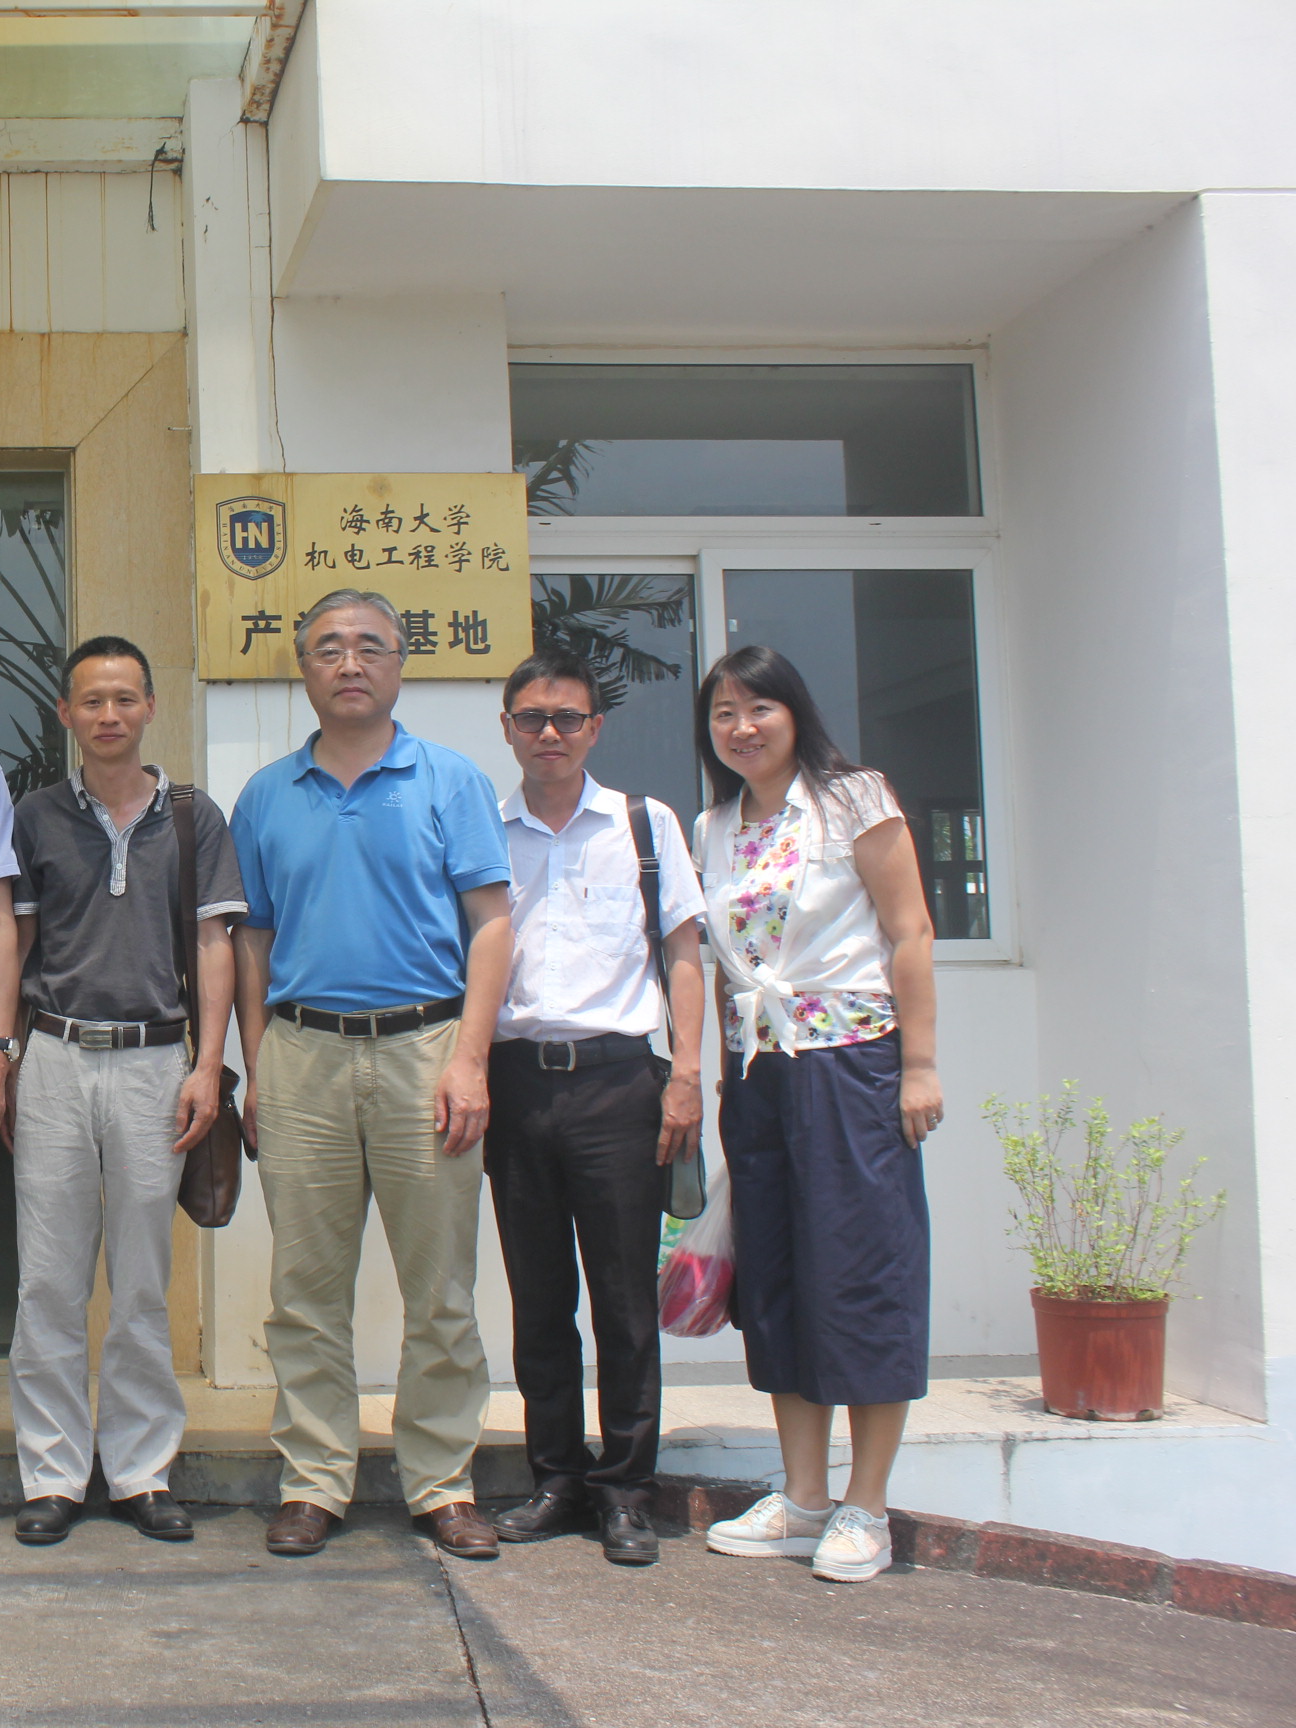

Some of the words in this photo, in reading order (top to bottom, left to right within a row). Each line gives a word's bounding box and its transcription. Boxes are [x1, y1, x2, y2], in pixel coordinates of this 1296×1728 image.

[234, 522, 270, 549] HN
[339, 502, 472, 536] 海南大学
[304, 541, 511, 573] 机电工程学院
[240, 609, 492, 655] 产基地
